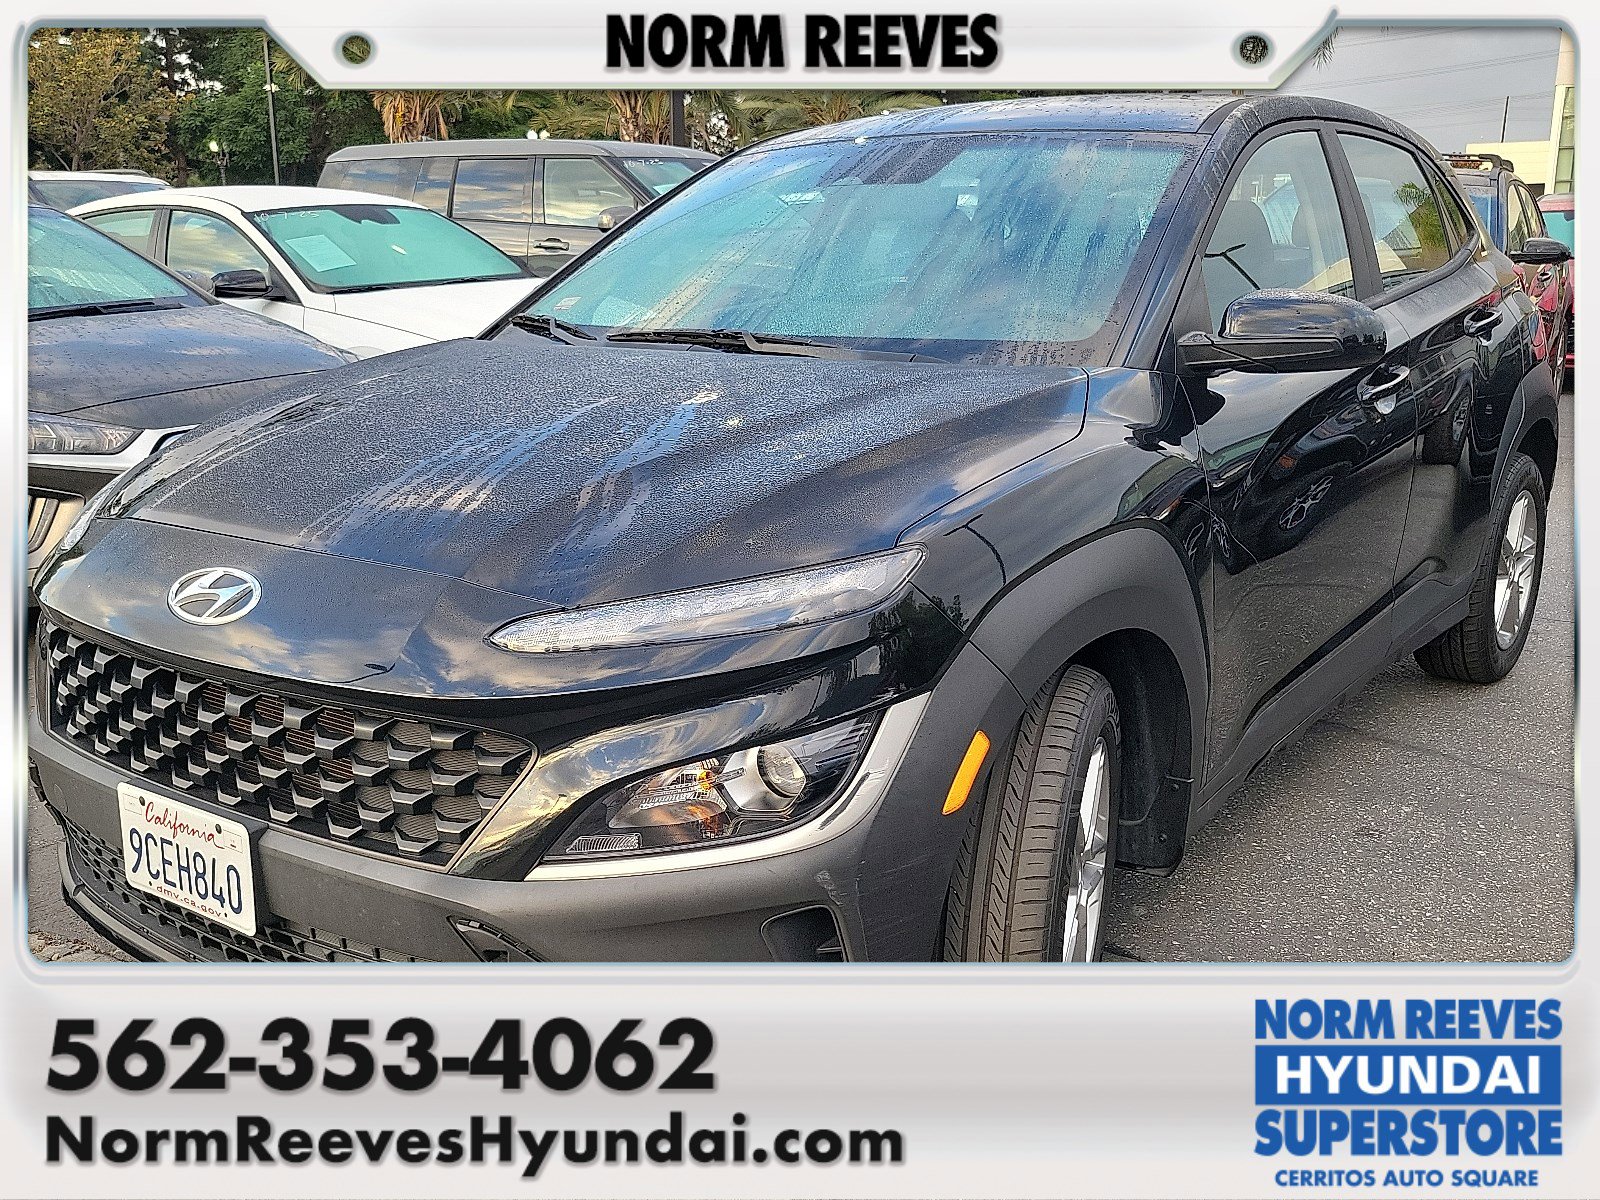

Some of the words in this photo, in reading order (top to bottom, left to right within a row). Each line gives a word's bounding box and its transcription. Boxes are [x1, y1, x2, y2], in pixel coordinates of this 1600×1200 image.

[144, 800, 226, 850] California
[129, 827, 243, 915] 9CEH840
[156, 885, 222, 918] dmv.ca.gov
